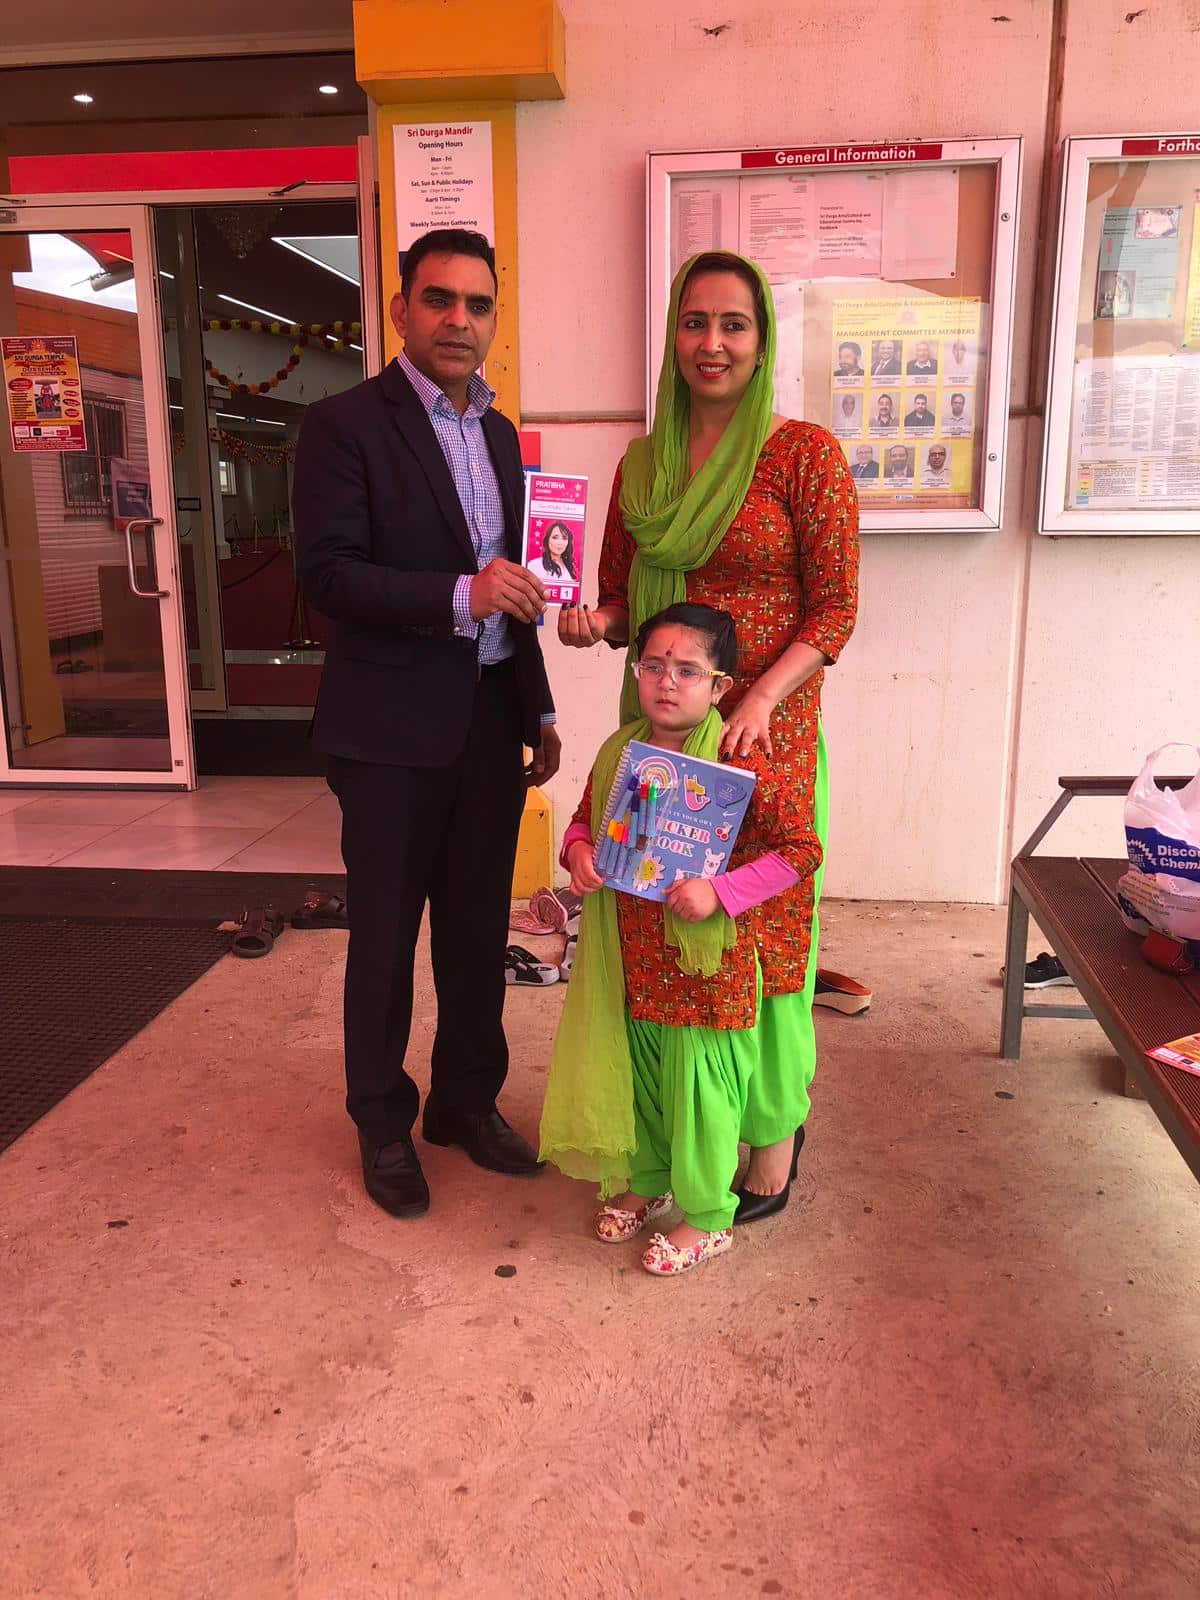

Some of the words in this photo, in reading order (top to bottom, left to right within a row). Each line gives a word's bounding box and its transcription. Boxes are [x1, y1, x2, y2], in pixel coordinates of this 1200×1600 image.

[407, 128, 418, 137] Sri
[420, 128, 443, 138] Durga
[445, 126, 473, 136] Mandir
[418, 141, 444, 150] Opening
[775, 148, 830, 164] General
[834, 146, 916, 161] Information
[410, 221, 429, 229] Weekly
[450, 219, 477, 227] Gathering
[836, 329, 890, 337] MANAGEMENT
[892, 328, 936, 336] COMMITTEE
[938, 327, 976, 335] MEMBERS
[664, 820, 711, 845] CKER
[657, 836, 695, 858] OOK
